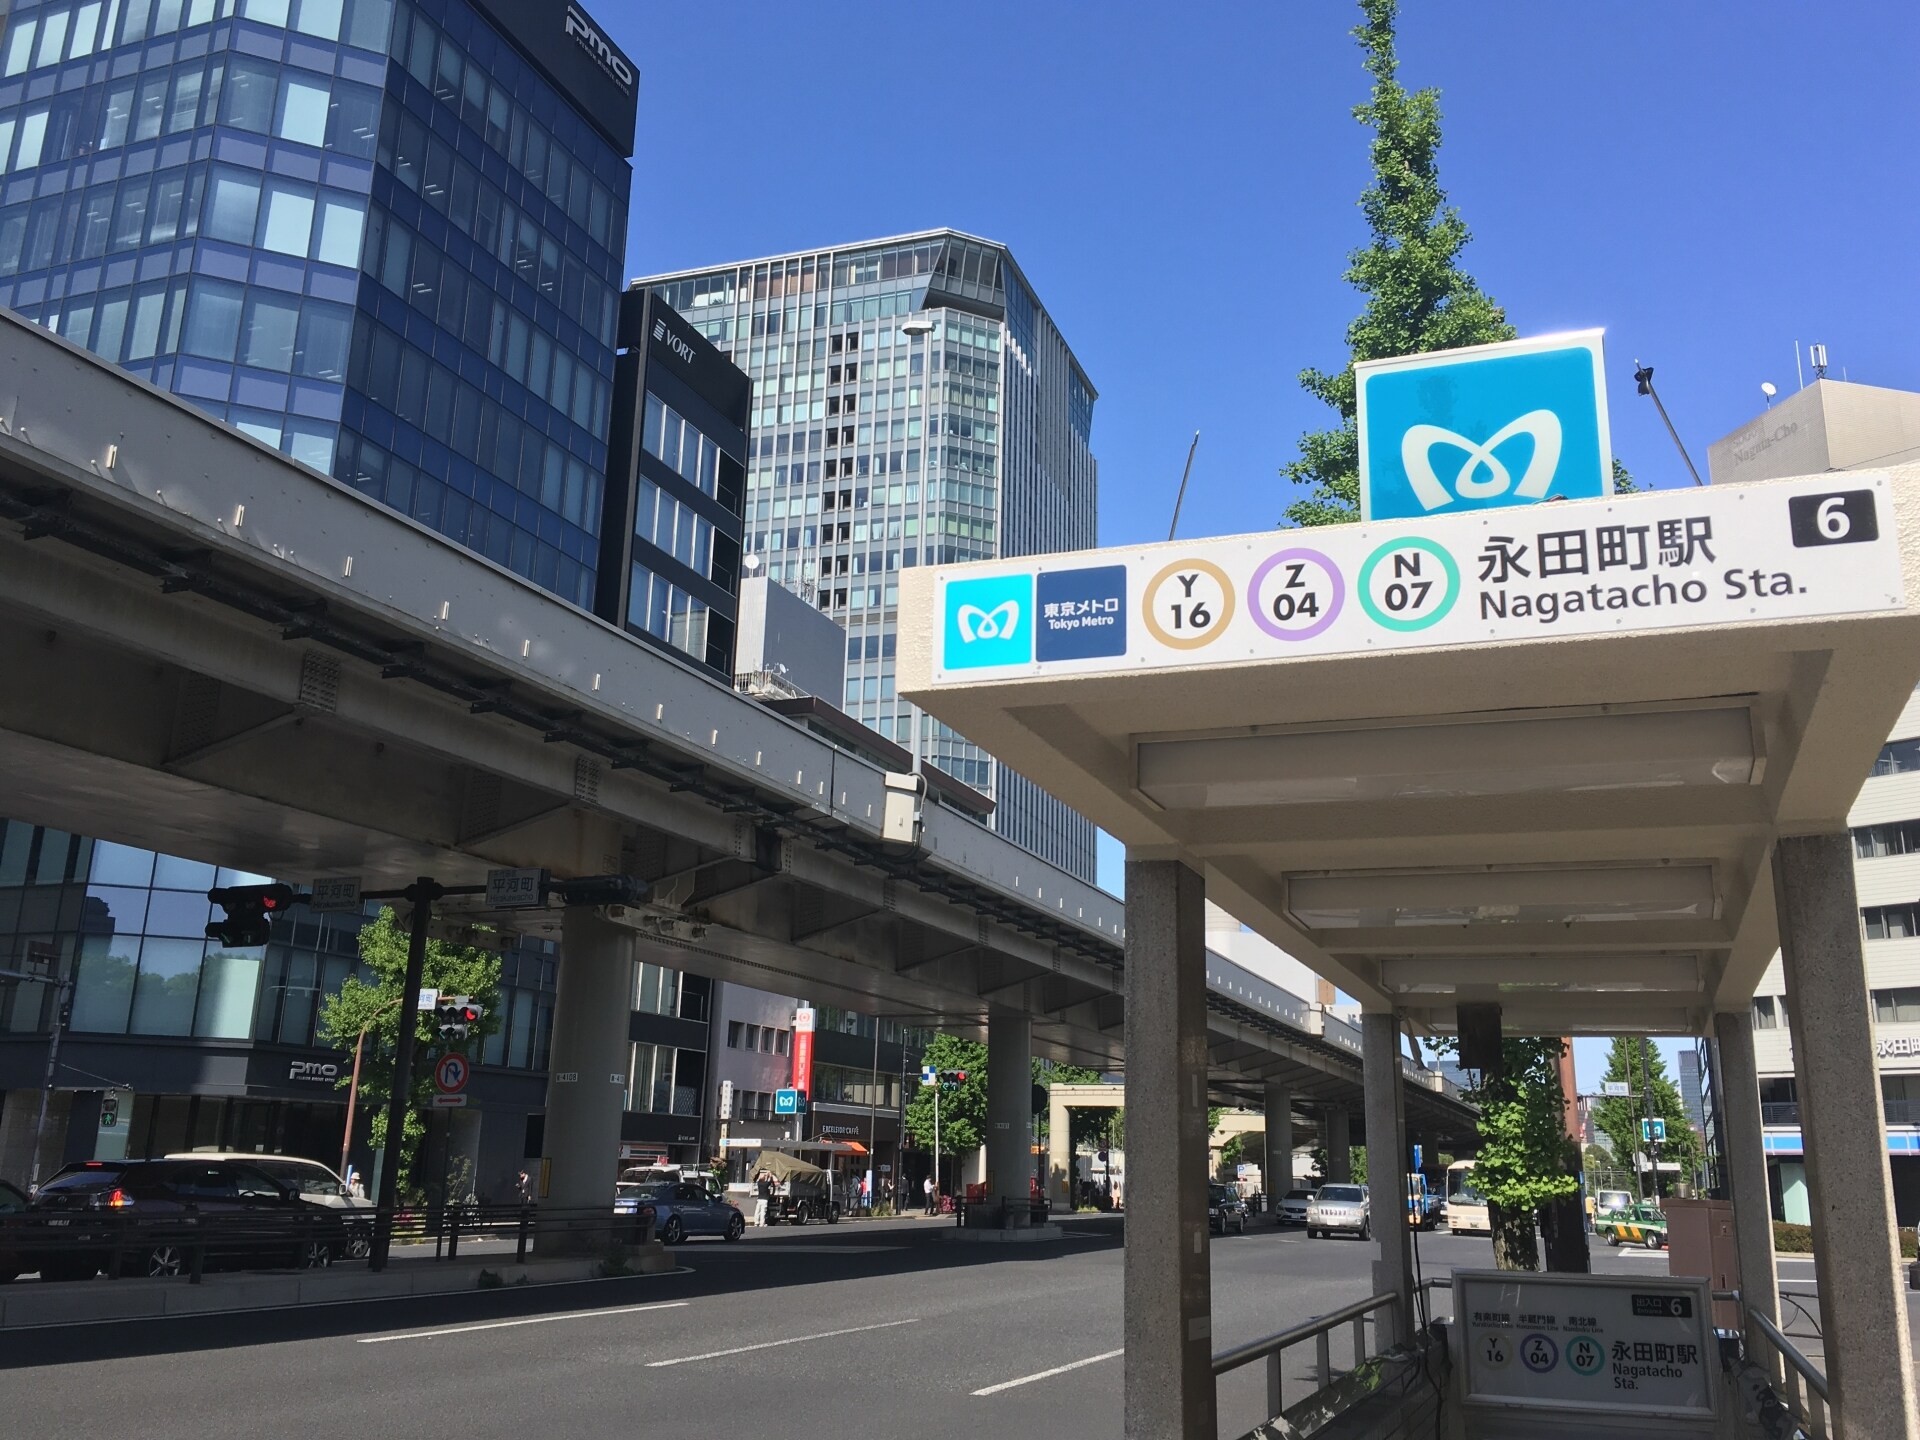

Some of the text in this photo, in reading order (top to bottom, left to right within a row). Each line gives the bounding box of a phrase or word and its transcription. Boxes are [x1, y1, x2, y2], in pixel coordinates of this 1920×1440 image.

[666, 329, 696, 364] VORT
[1816, 497, 1851, 540] 6
[1478, 515, 1717, 584] 永田町駅
[1394, 552, 1421, 578] N
[1285, 563, 1305, 588] Z
[1177, 574, 1199, 598] Y
[1385, 581, 1433, 611] 07
[1480, 568, 1807, 624] Nagatacho Sta.
[1044, 598, 1119, 618] 東京メトロ
[1273, 592, 1319, 621] 04
[1048, 615, 1114, 631] Tokyo Metro
[1171, 602, 1211, 629] 16
[317, 883, 355, 899] 平河町
[492, 877, 534, 894] 平河町
[1636, 1298, 1662, 1307] 出入口
[1670, 1298, 1682, 1316] 6
[1568, 1316, 1597, 1327] 南北線
[1489, 1338, 1498, 1349] Y
[1534, 1340, 1543, 1351] Z
[1579, 1342, 1590, 1354] N
[1487, 1350, 1504, 1362] 16
[1530, 1353, 1549, 1365] 04
[1576, 1355, 1595, 1367] 07
[1612, 1340, 1698, 1365] 永田町駅
[1612, 1363, 1683, 1380] Nagatacho
[1614, 1377, 1639, 1390] Sta.
